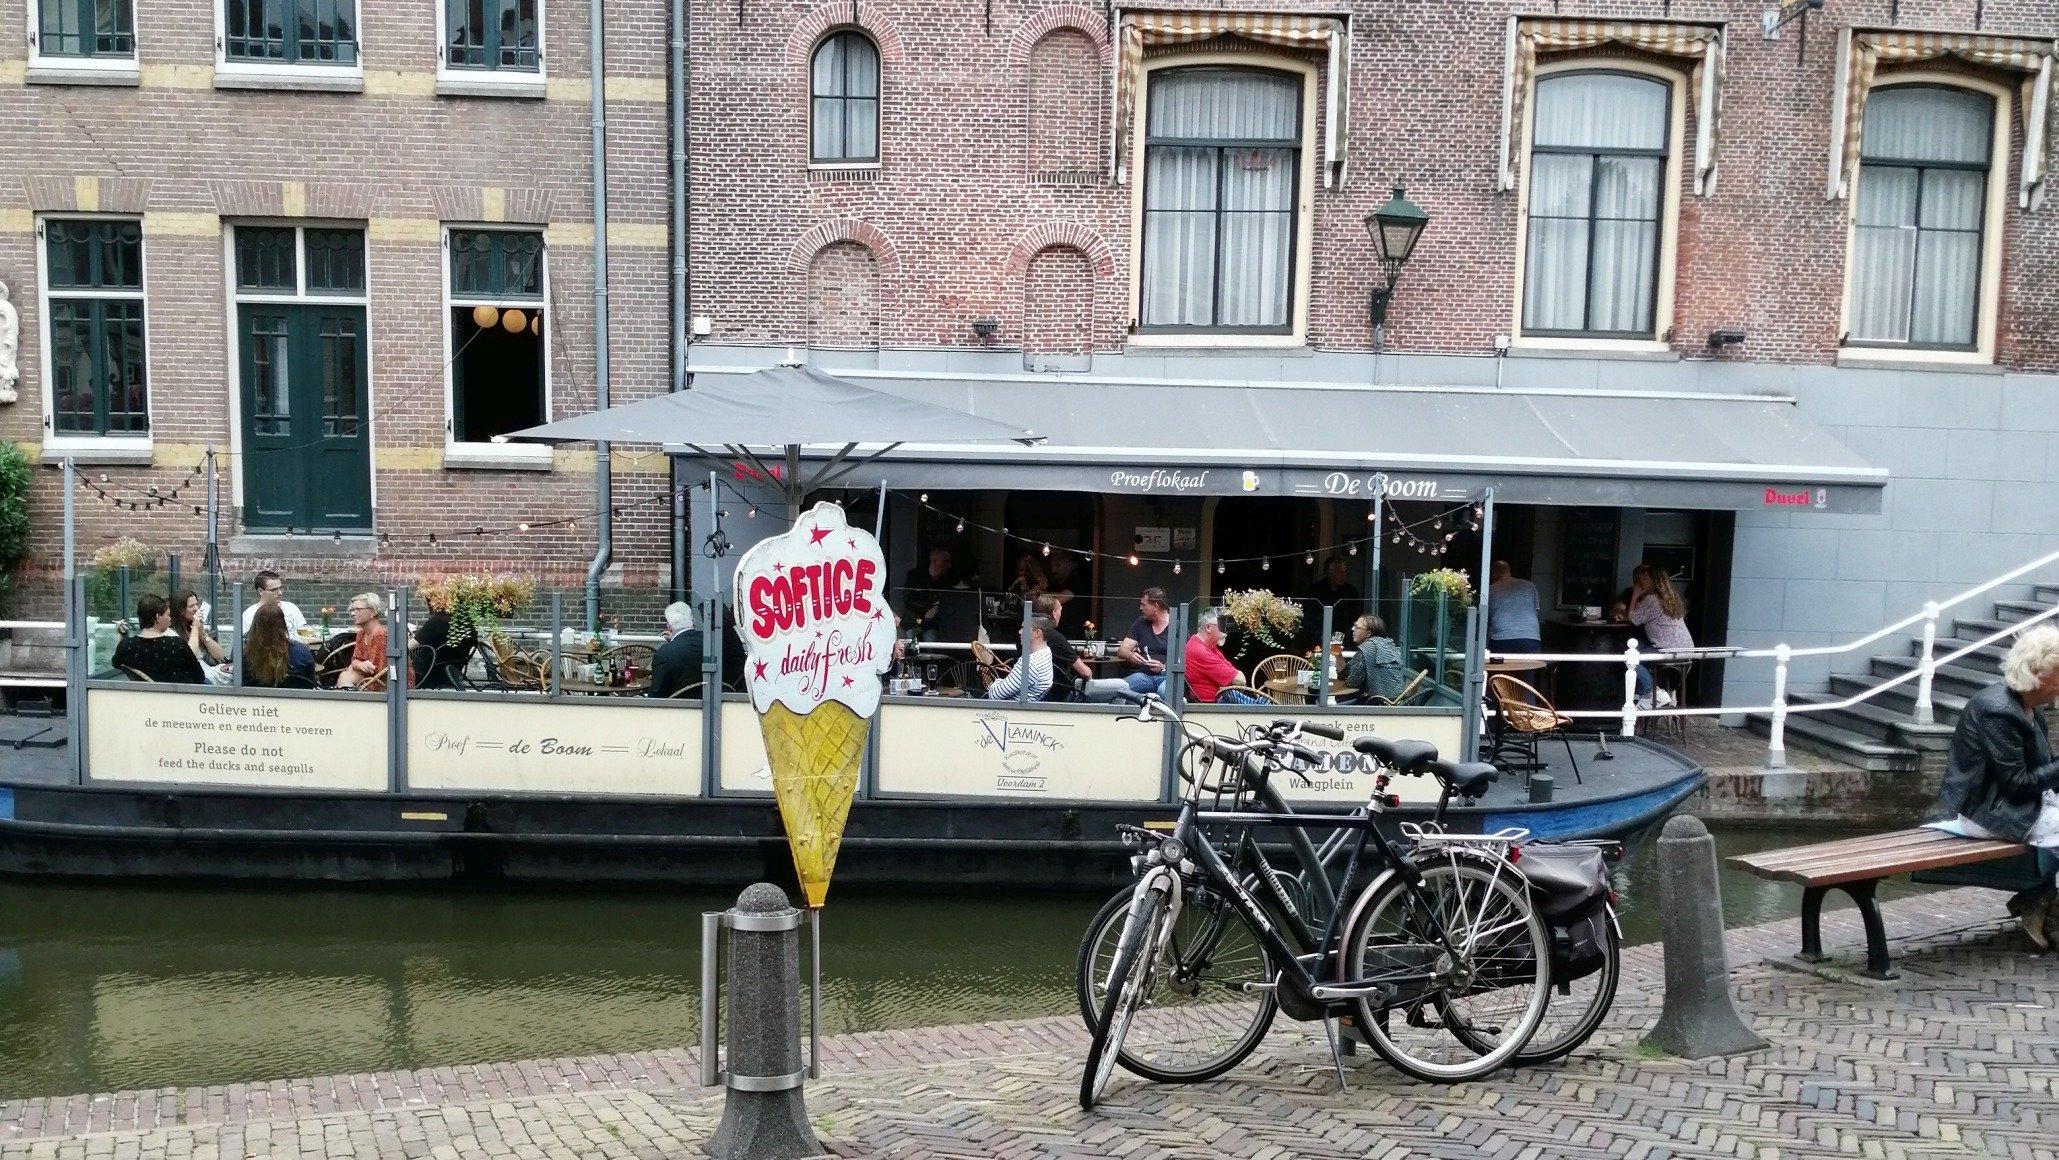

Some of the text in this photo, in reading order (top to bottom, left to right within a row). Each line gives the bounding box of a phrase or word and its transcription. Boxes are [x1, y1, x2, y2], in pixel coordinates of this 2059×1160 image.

[1110, 469, 1210, 491] Proeflokaal
[1324, 472, 1439, 499] De Boom
[1765, 487, 1810, 505] Duvel
[749, 558, 877, 640] SOFTICE
[775, 621, 876, 701] daily fresh
[199, 702, 279, 718] Gelieve niet
[144, 718, 333, 736] de meeuwen en eenden te voeren
[1346, 722, 1376, 732] eens
[194, 742, 284, 757] Please do not
[424, 730, 688, 760] Proef de Boom Lokaal
[158, 757, 315, 776] feed the ducks and seagulls
[1039, 779, 1045, 788] 2
[1289, 778, 1354, 792] Waagplein
